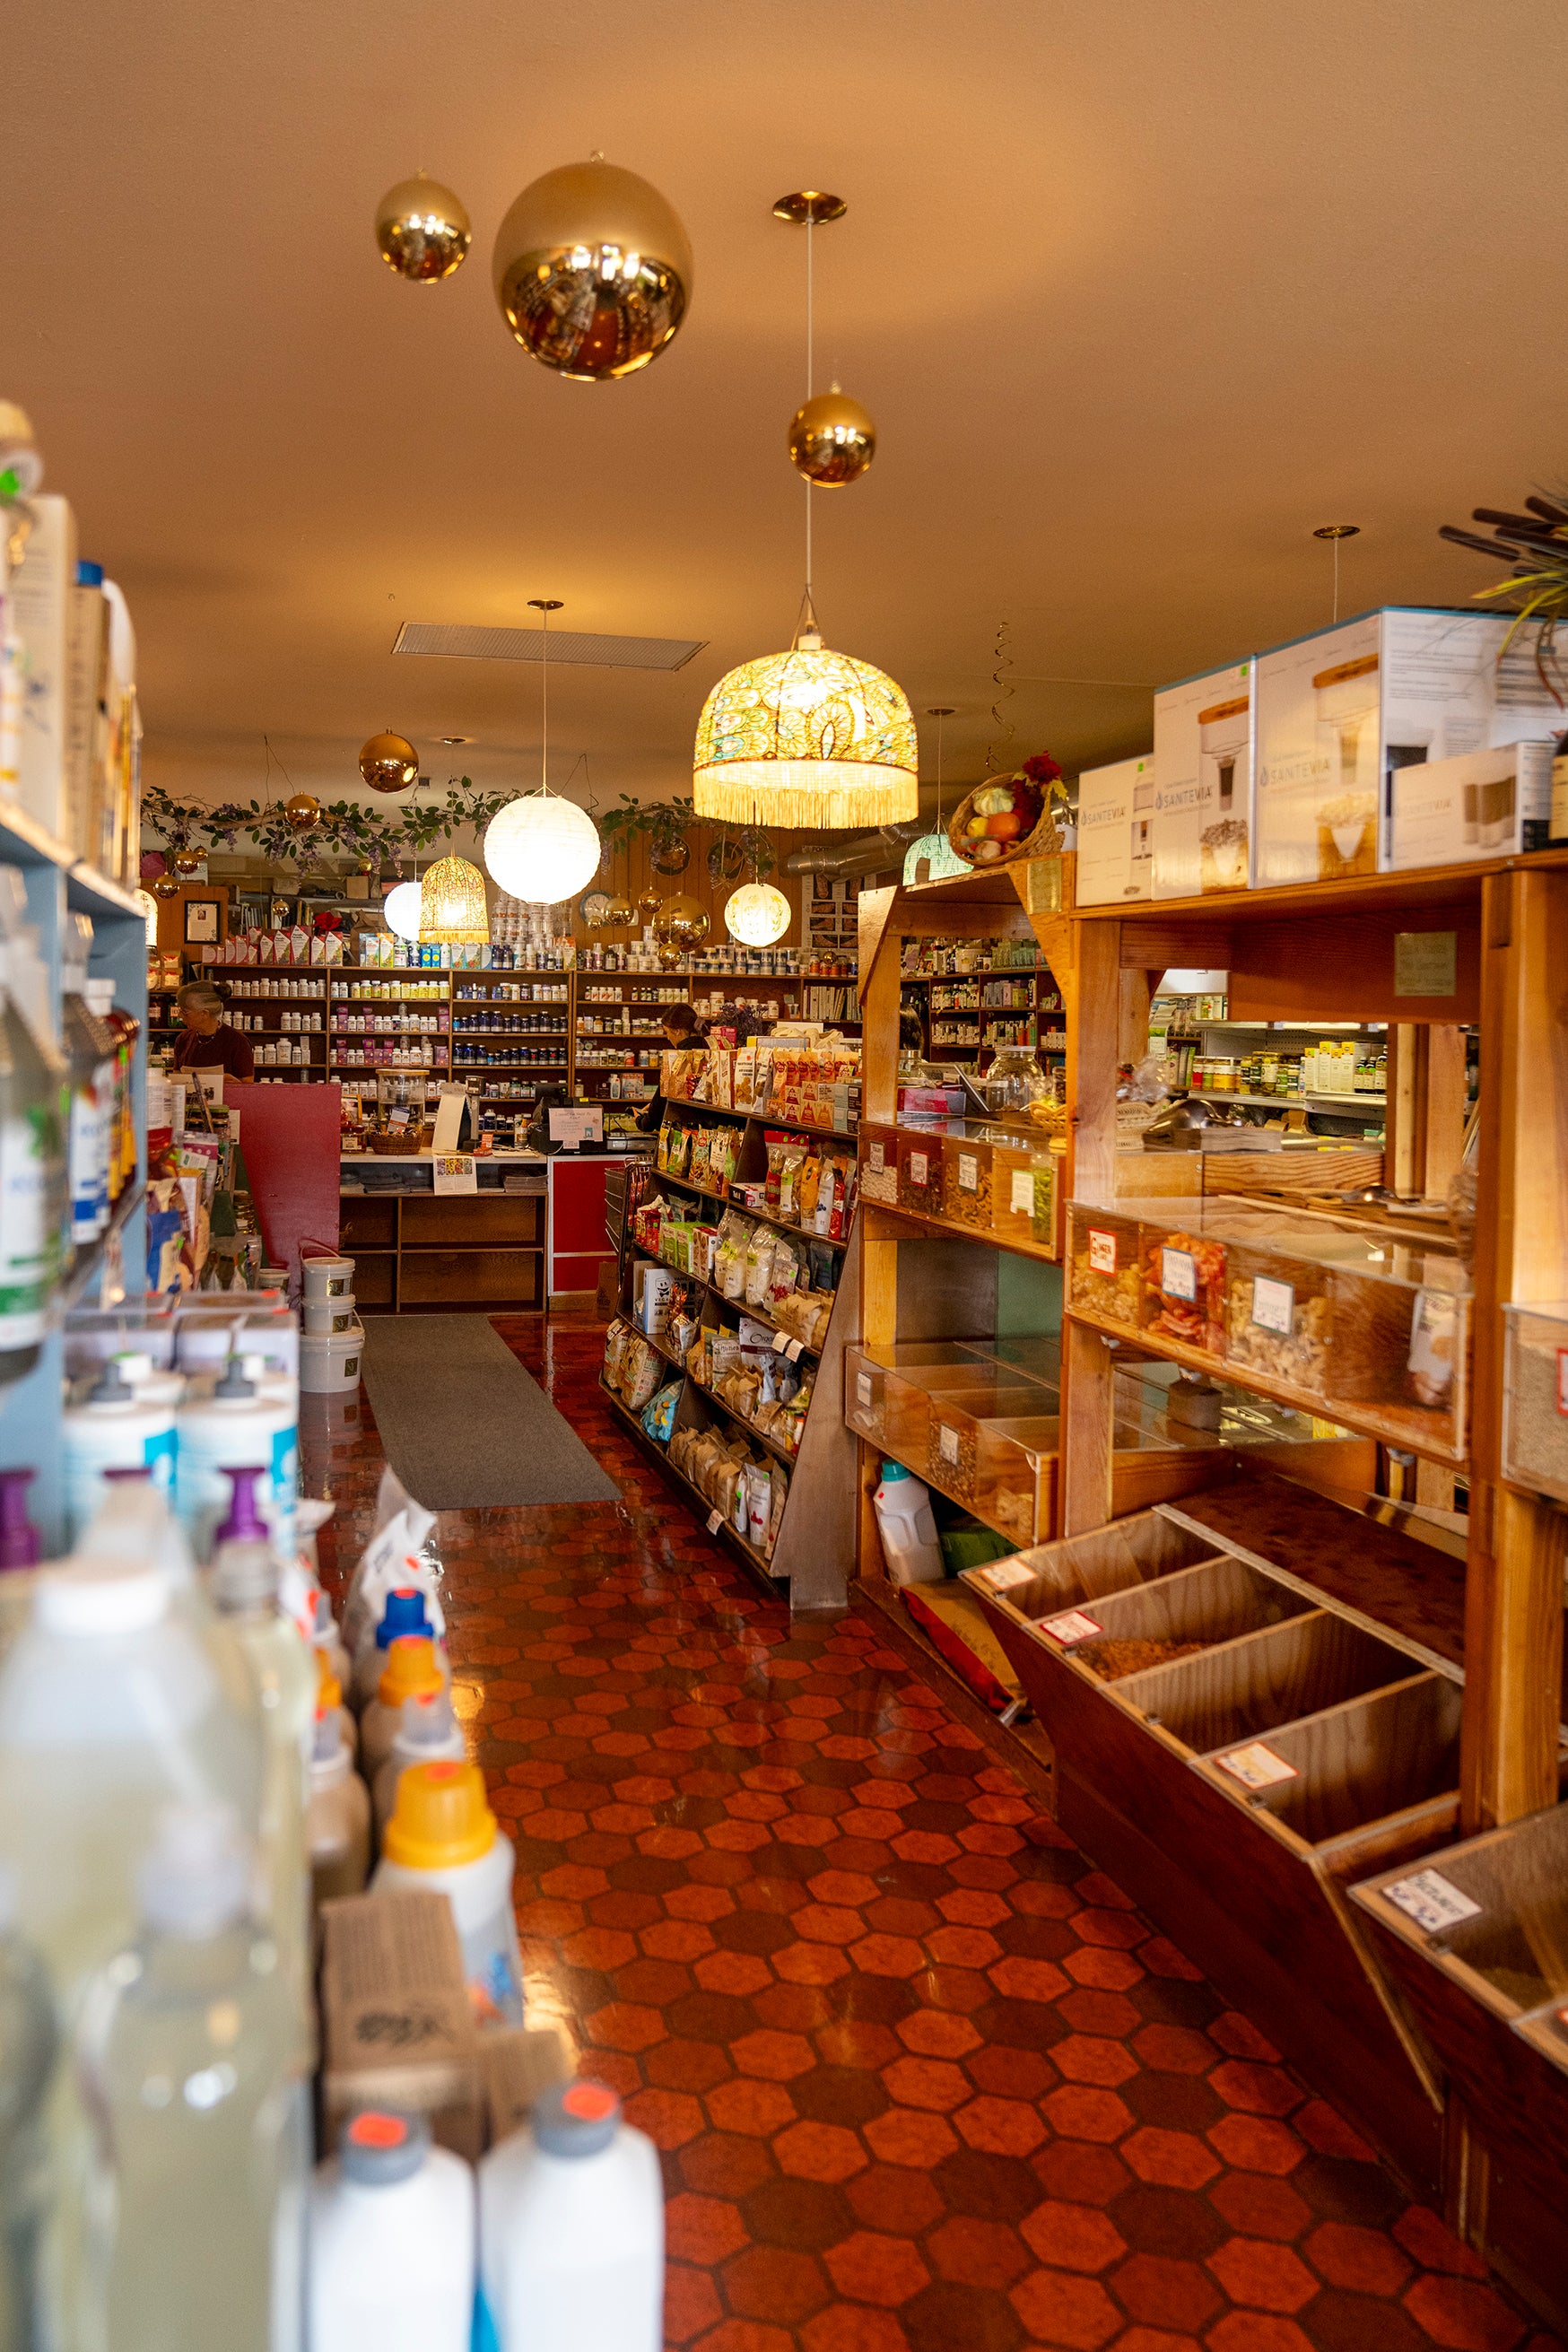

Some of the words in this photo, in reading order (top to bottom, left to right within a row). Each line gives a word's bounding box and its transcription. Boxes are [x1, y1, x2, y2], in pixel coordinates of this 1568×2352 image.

[1270, 758, 1329, 784] SANTEVIA
[1163, 786, 1212, 808] SANTEVIA
[1087, 806, 1126, 824] SANTEVIA
